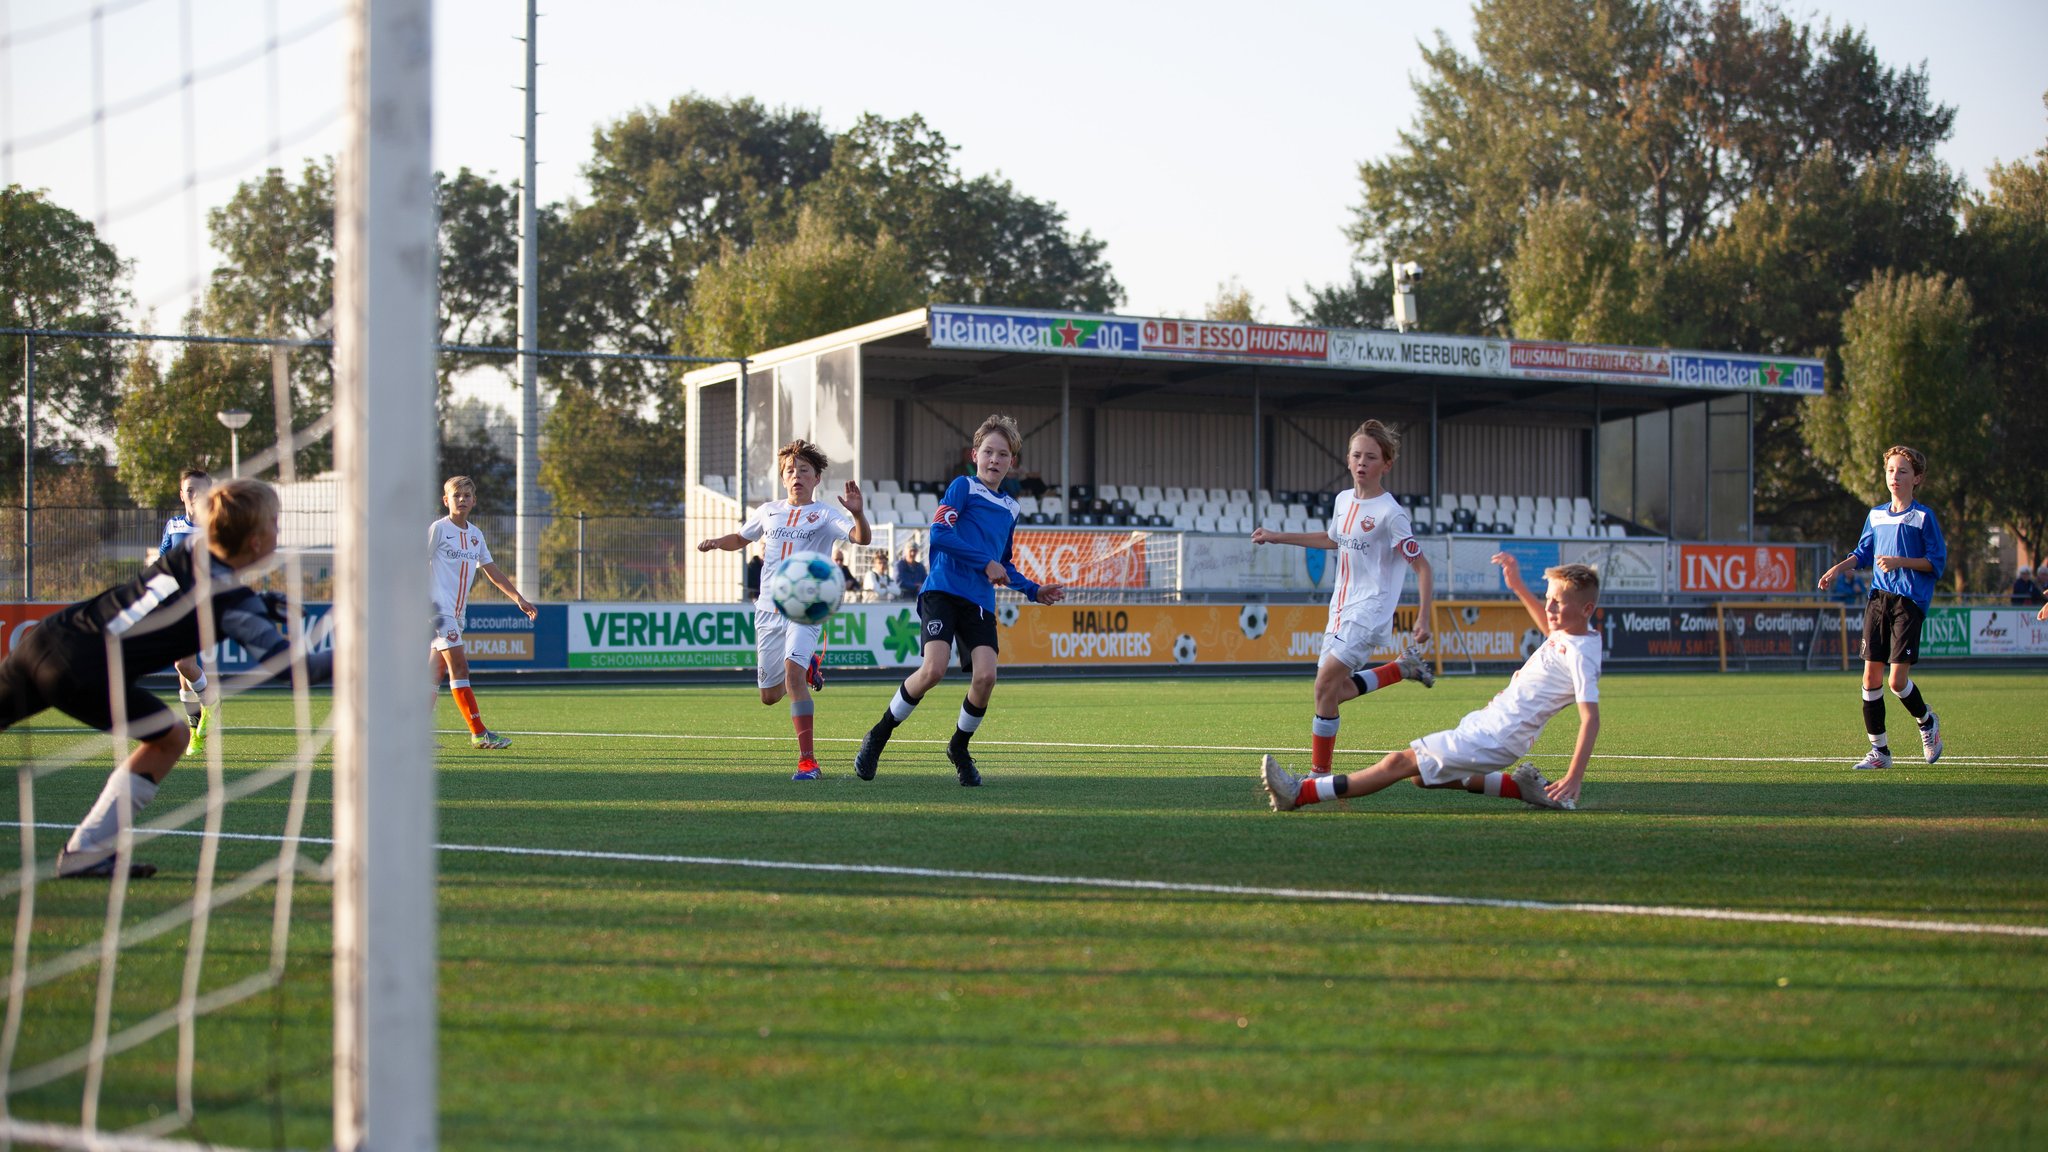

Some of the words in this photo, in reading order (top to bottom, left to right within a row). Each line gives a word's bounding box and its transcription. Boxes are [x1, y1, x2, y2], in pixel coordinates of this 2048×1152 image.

[933, 312, 1053, 348] Heineken
[1200, 326, 1244, 348] ESSO
[1250, 328, 1326, 353] HUISMAN
[1358, 341, 1397, 362] r.k.v.v.
[1401, 343, 1481, 366] MEERBURG
[1511, 350, 1566, 369] HUISMAN
[1567, 351, 1643, 371] TWEEWIELERS
[1673, 357, 1761, 387] Heineken
[1684, 554, 1747, 590] ING
[470, 615, 535, 629] accountants
[583, 612, 756, 647] VERHAGEN
[1072, 610, 1129, 634] HALLO
[1621, 610, 1671, 632] Vloeren
[1754, 612, 1814, 635] Gordijnen
[1050, 632, 1152, 657] TOPSPORTERS
[590, 653, 738, 667] SCHOONMAAKMACHINES
[744, 655, 752, 665] &
